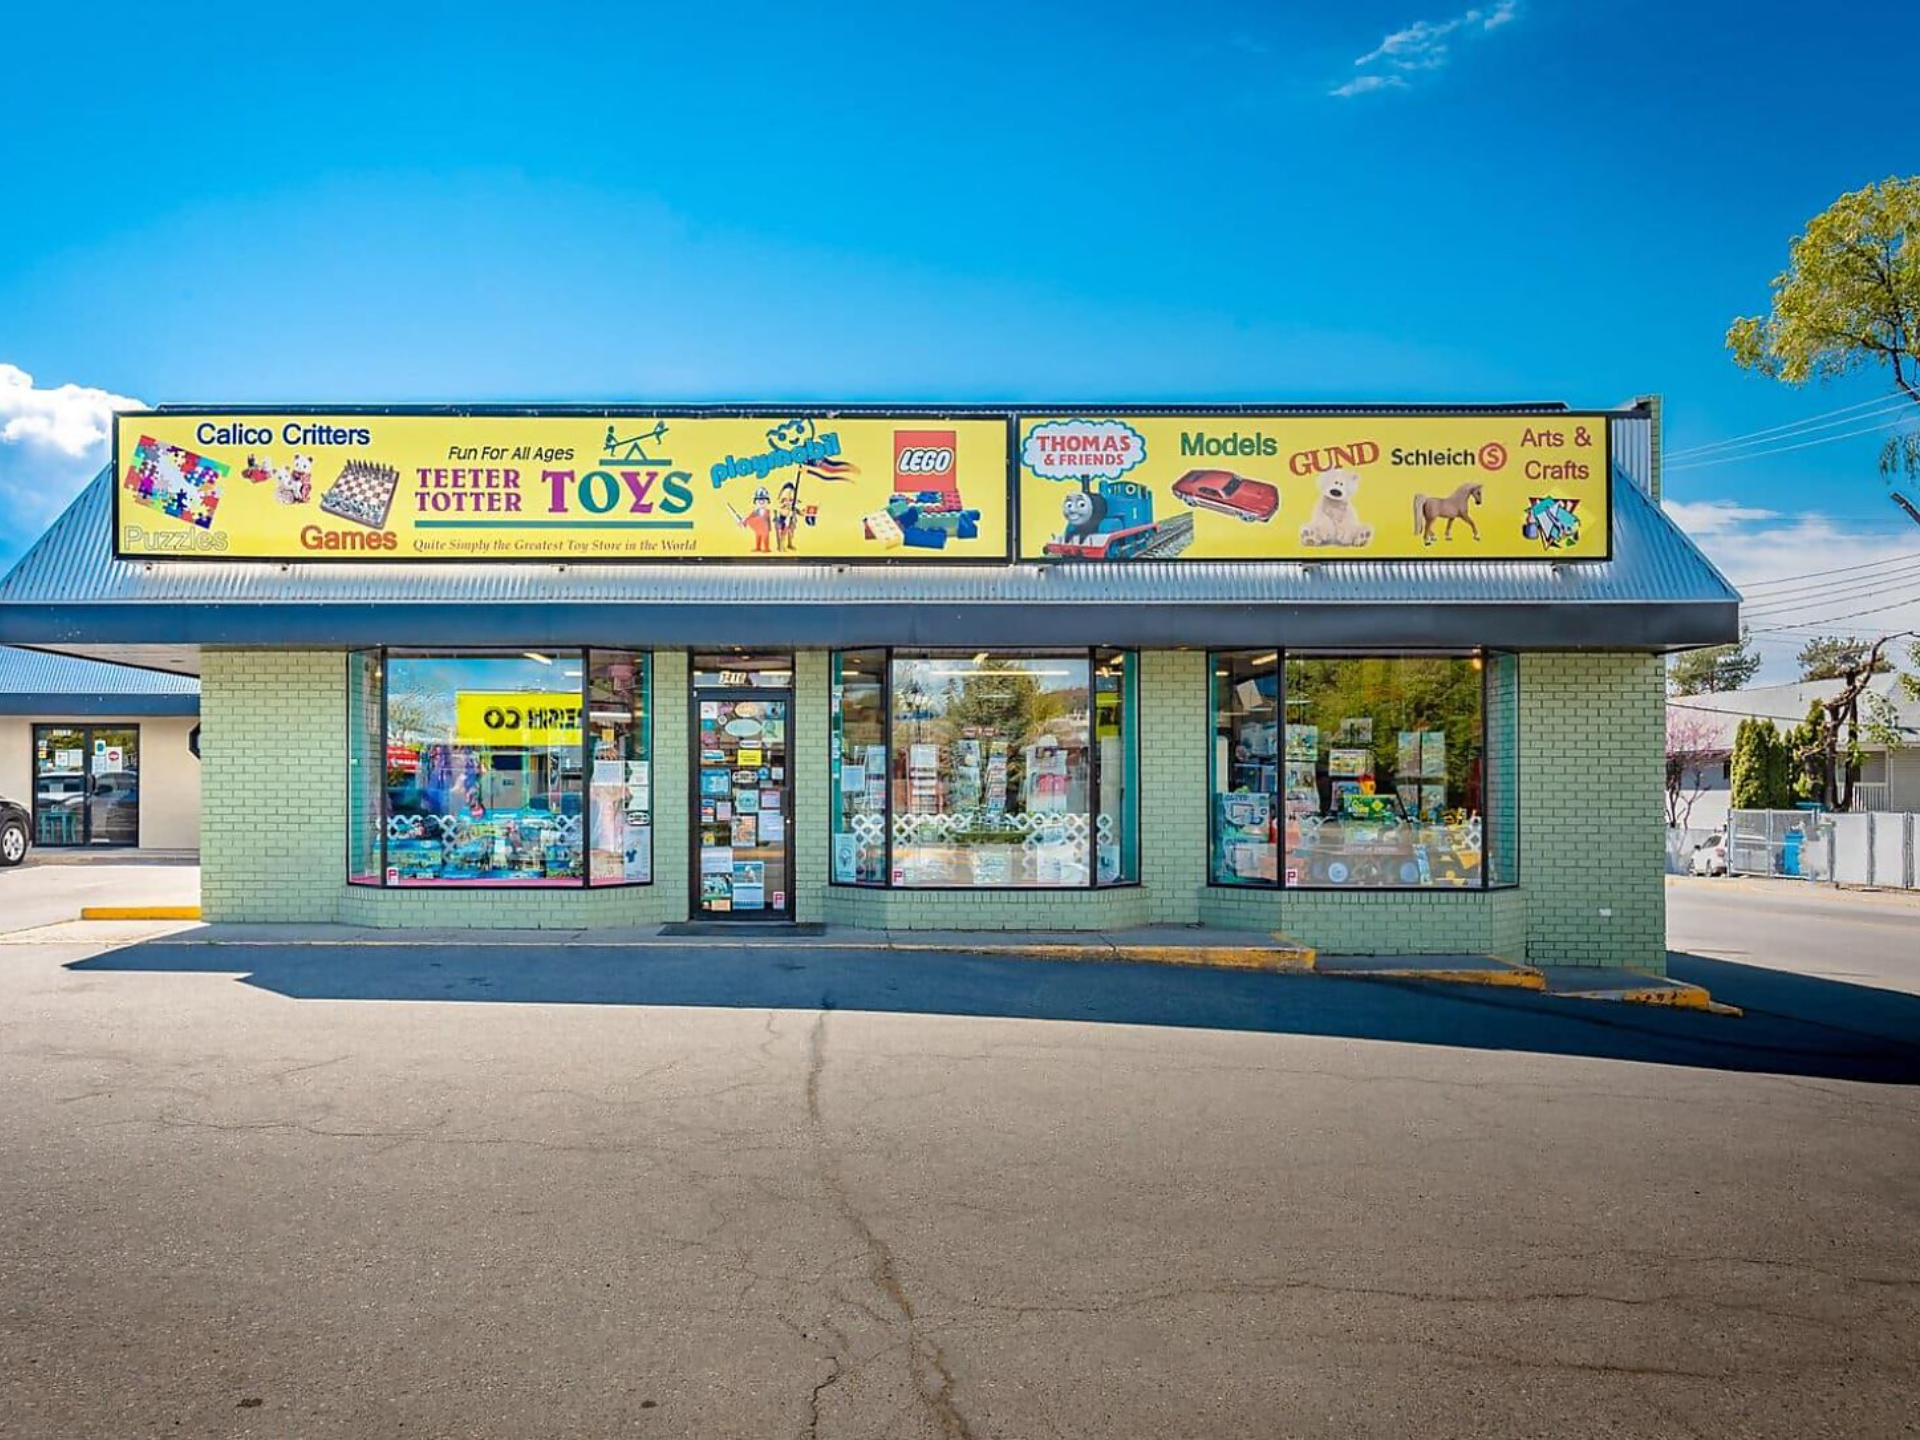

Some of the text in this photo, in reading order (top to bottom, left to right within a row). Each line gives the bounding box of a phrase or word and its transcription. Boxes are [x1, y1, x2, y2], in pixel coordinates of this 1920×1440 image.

[196, 423, 371, 445] Calico Critters
[1036, 435, 1131, 451] THOMAS
[1180, 432, 1278, 456] Models
[1521, 427, 1591, 447] Arts &
[448, 446, 574, 462] Fun For All Ages
[710, 432, 841, 488] playmobil
[899, 448, 953, 474] LEGO
[1044, 453, 1125, 466] & FRIENDS
[1289, 441, 1380, 476] GUND
[1391, 448, 1475, 466] Schleich
[416, 468, 521, 488] TEETER
[1524, 460, 1589, 480] Crafts
[415, 491, 522, 512] TOTTER
[541, 470, 693, 514] TOYS
[123, 525, 229, 551] Puzzles
[300, 525, 398, 551] Games
[413, 539, 697, 554] Quite Simply the Greatest Toy Store in the World
